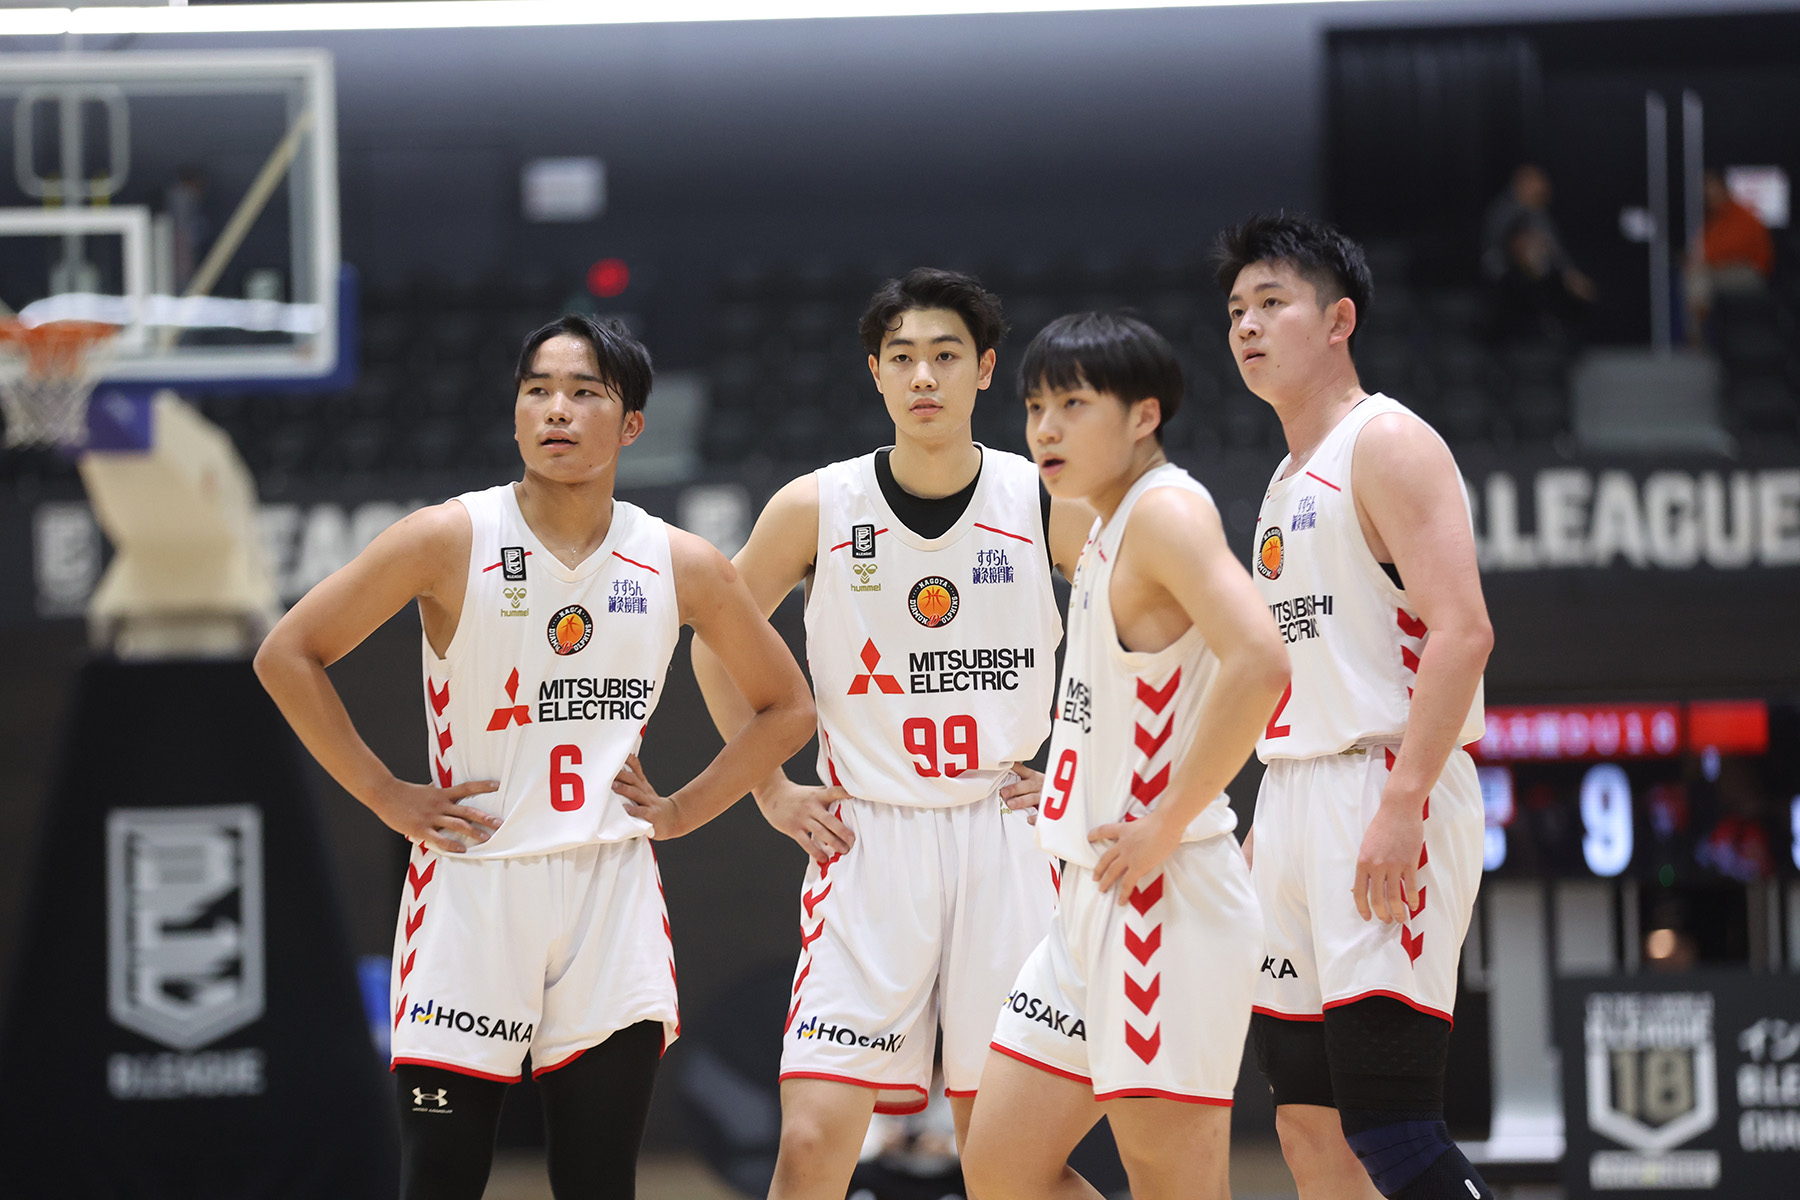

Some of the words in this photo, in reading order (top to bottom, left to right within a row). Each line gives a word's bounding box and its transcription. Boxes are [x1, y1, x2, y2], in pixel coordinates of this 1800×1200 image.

[1473, 469, 1800, 572] .LEAGUE
[851, 583, 881, 592] hummel
[918, 578, 948, 588] NAGOYA
[501, 608, 529, 617] hummel
[1268, 595, 1333, 622] ITSUBISHI
[909, 648, 1034, 672] MITSUBISHI
[539, 678, 656, 701] MITSUBISH
[910, 670, 1019, 694] ELECTRIC
[539, 700, 647, 723] ELECTRIC
[902, 714, 979, 778] 99
[549, 744, 586, 812] 6
[1043, 748, 1078, 821] 9
[1579, 761, 1634, 877] 9
[434, 1006, 533, 1043] HOSAKA
